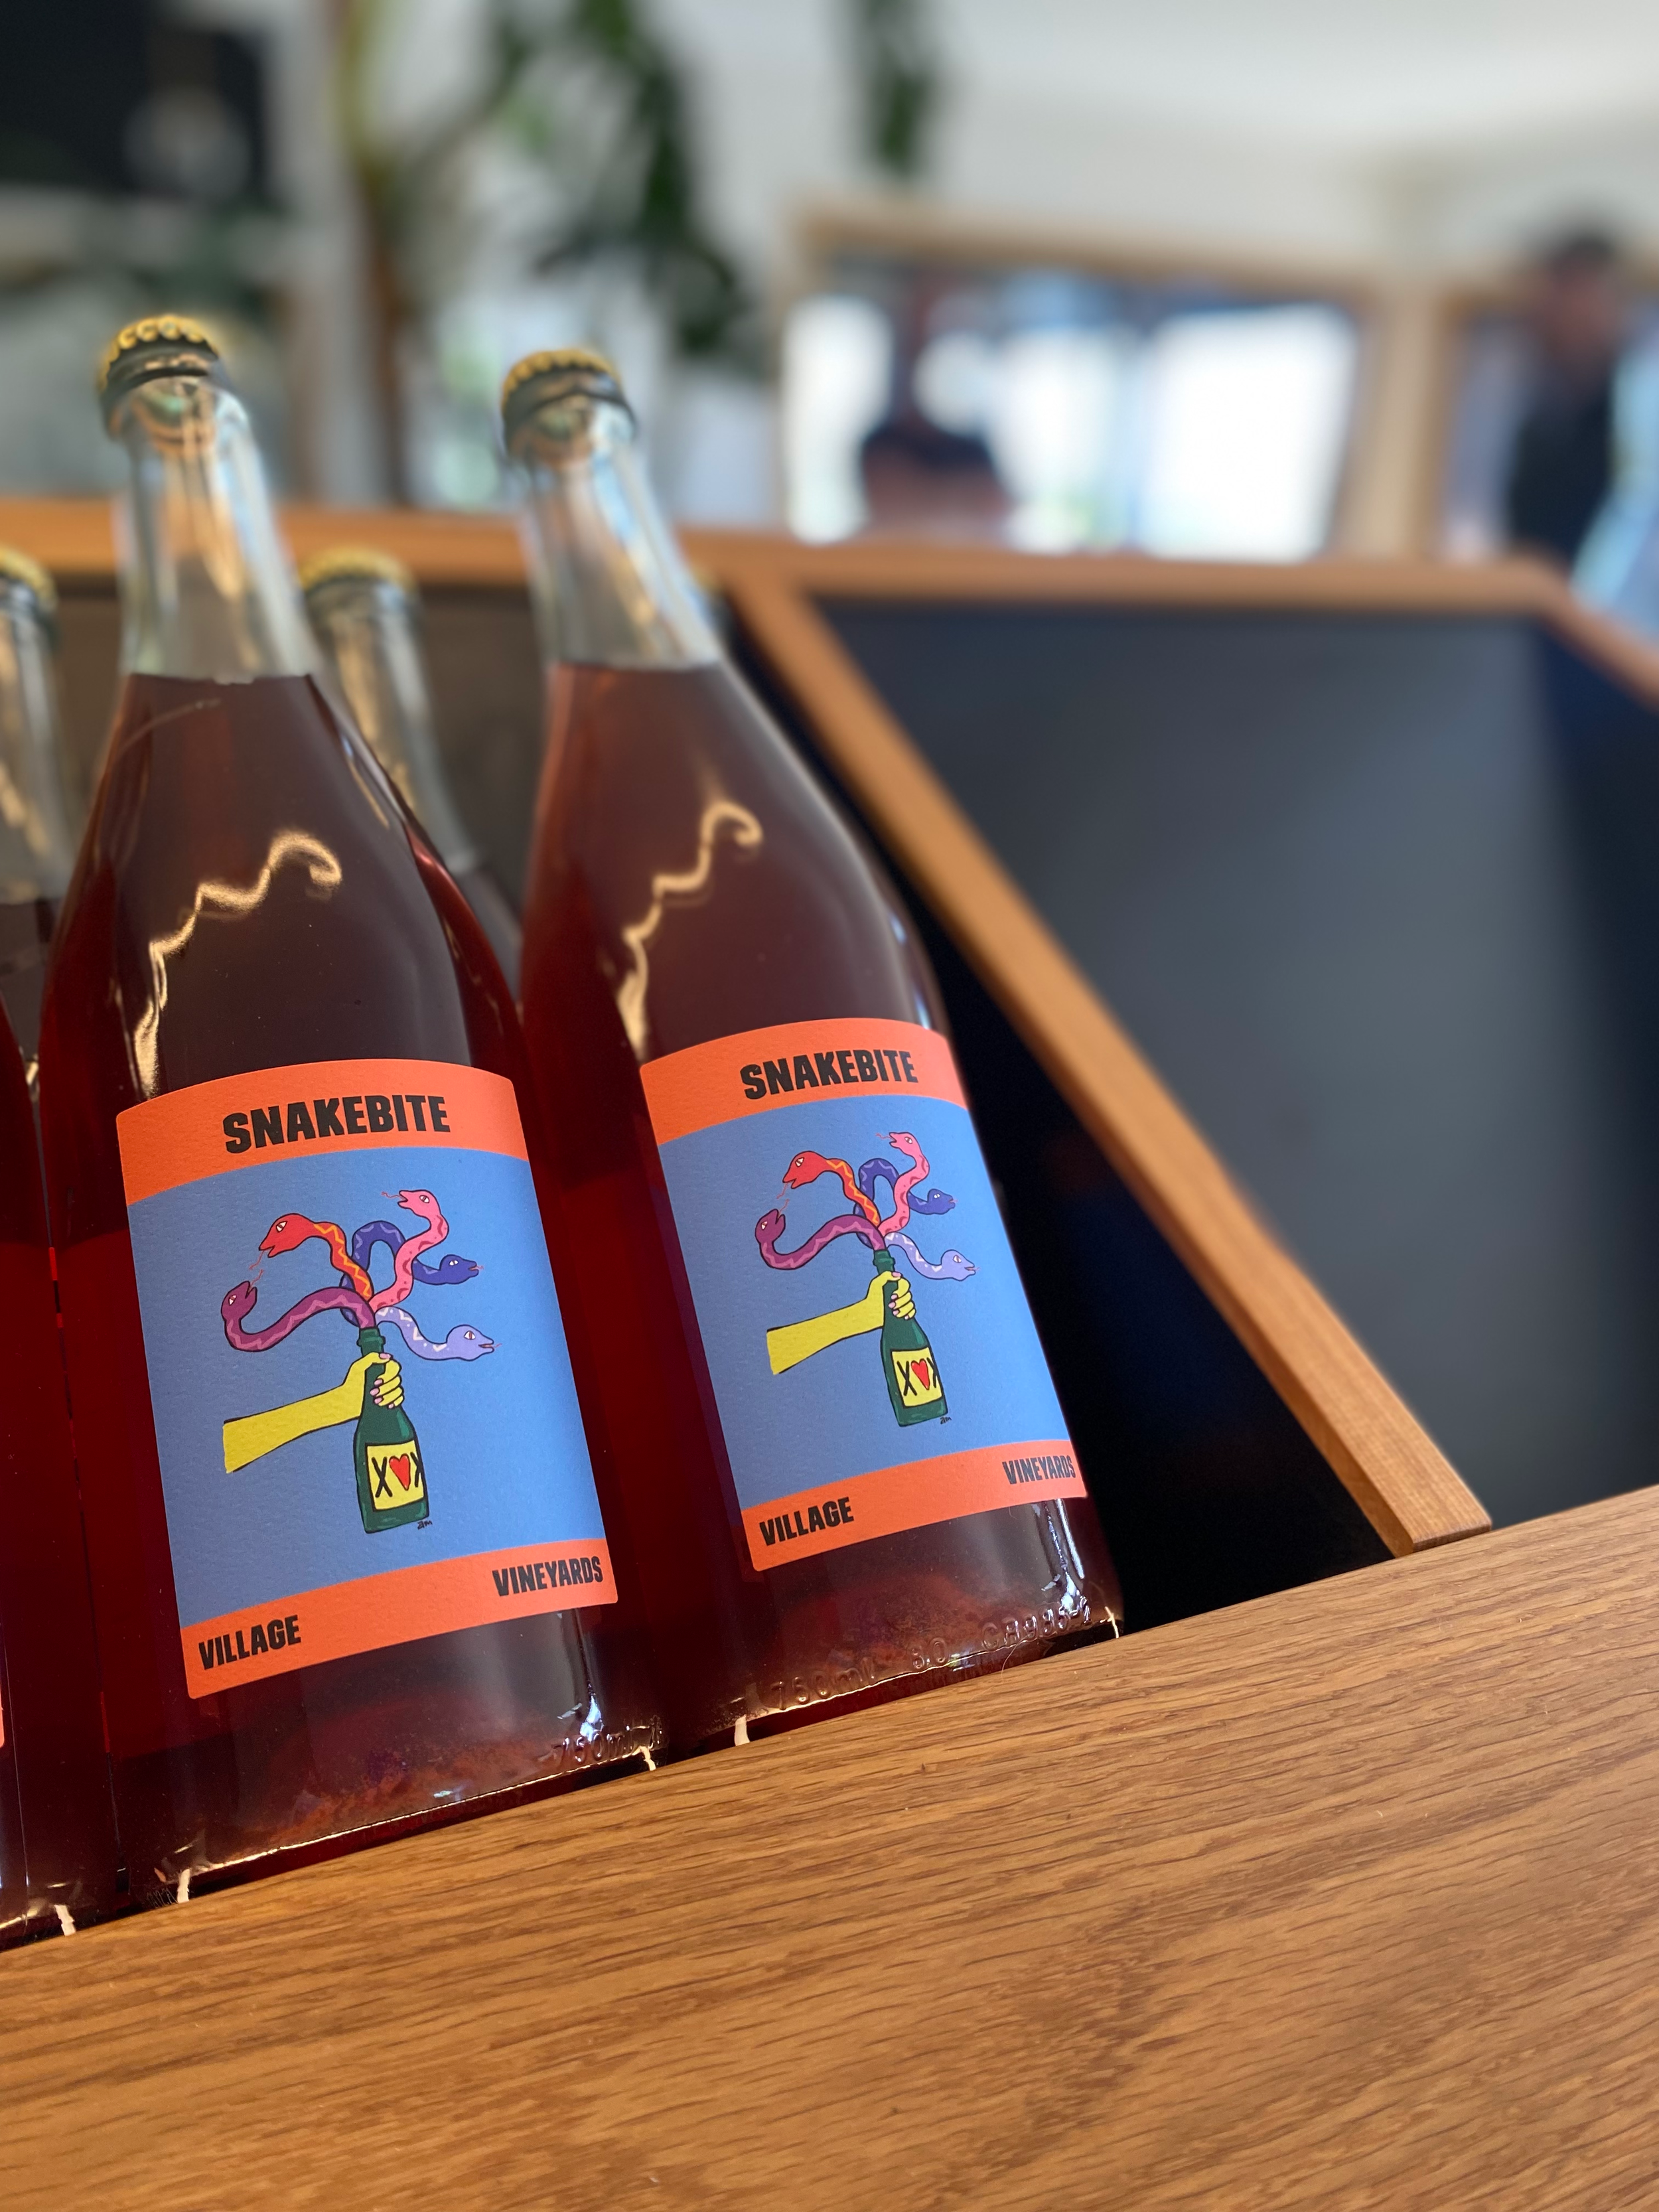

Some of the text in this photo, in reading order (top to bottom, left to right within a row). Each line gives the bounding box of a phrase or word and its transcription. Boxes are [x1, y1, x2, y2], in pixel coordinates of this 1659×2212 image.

[740, 1049, 918, 1100] SNAKEBITE
[222, 1094, 450, 1154] SNAKEBITE
[759, 1455, 1076, 1546] VILLAGE VINEYARDS
[199, 1556, 603, 1670] VILLAGE VINEYARDS
